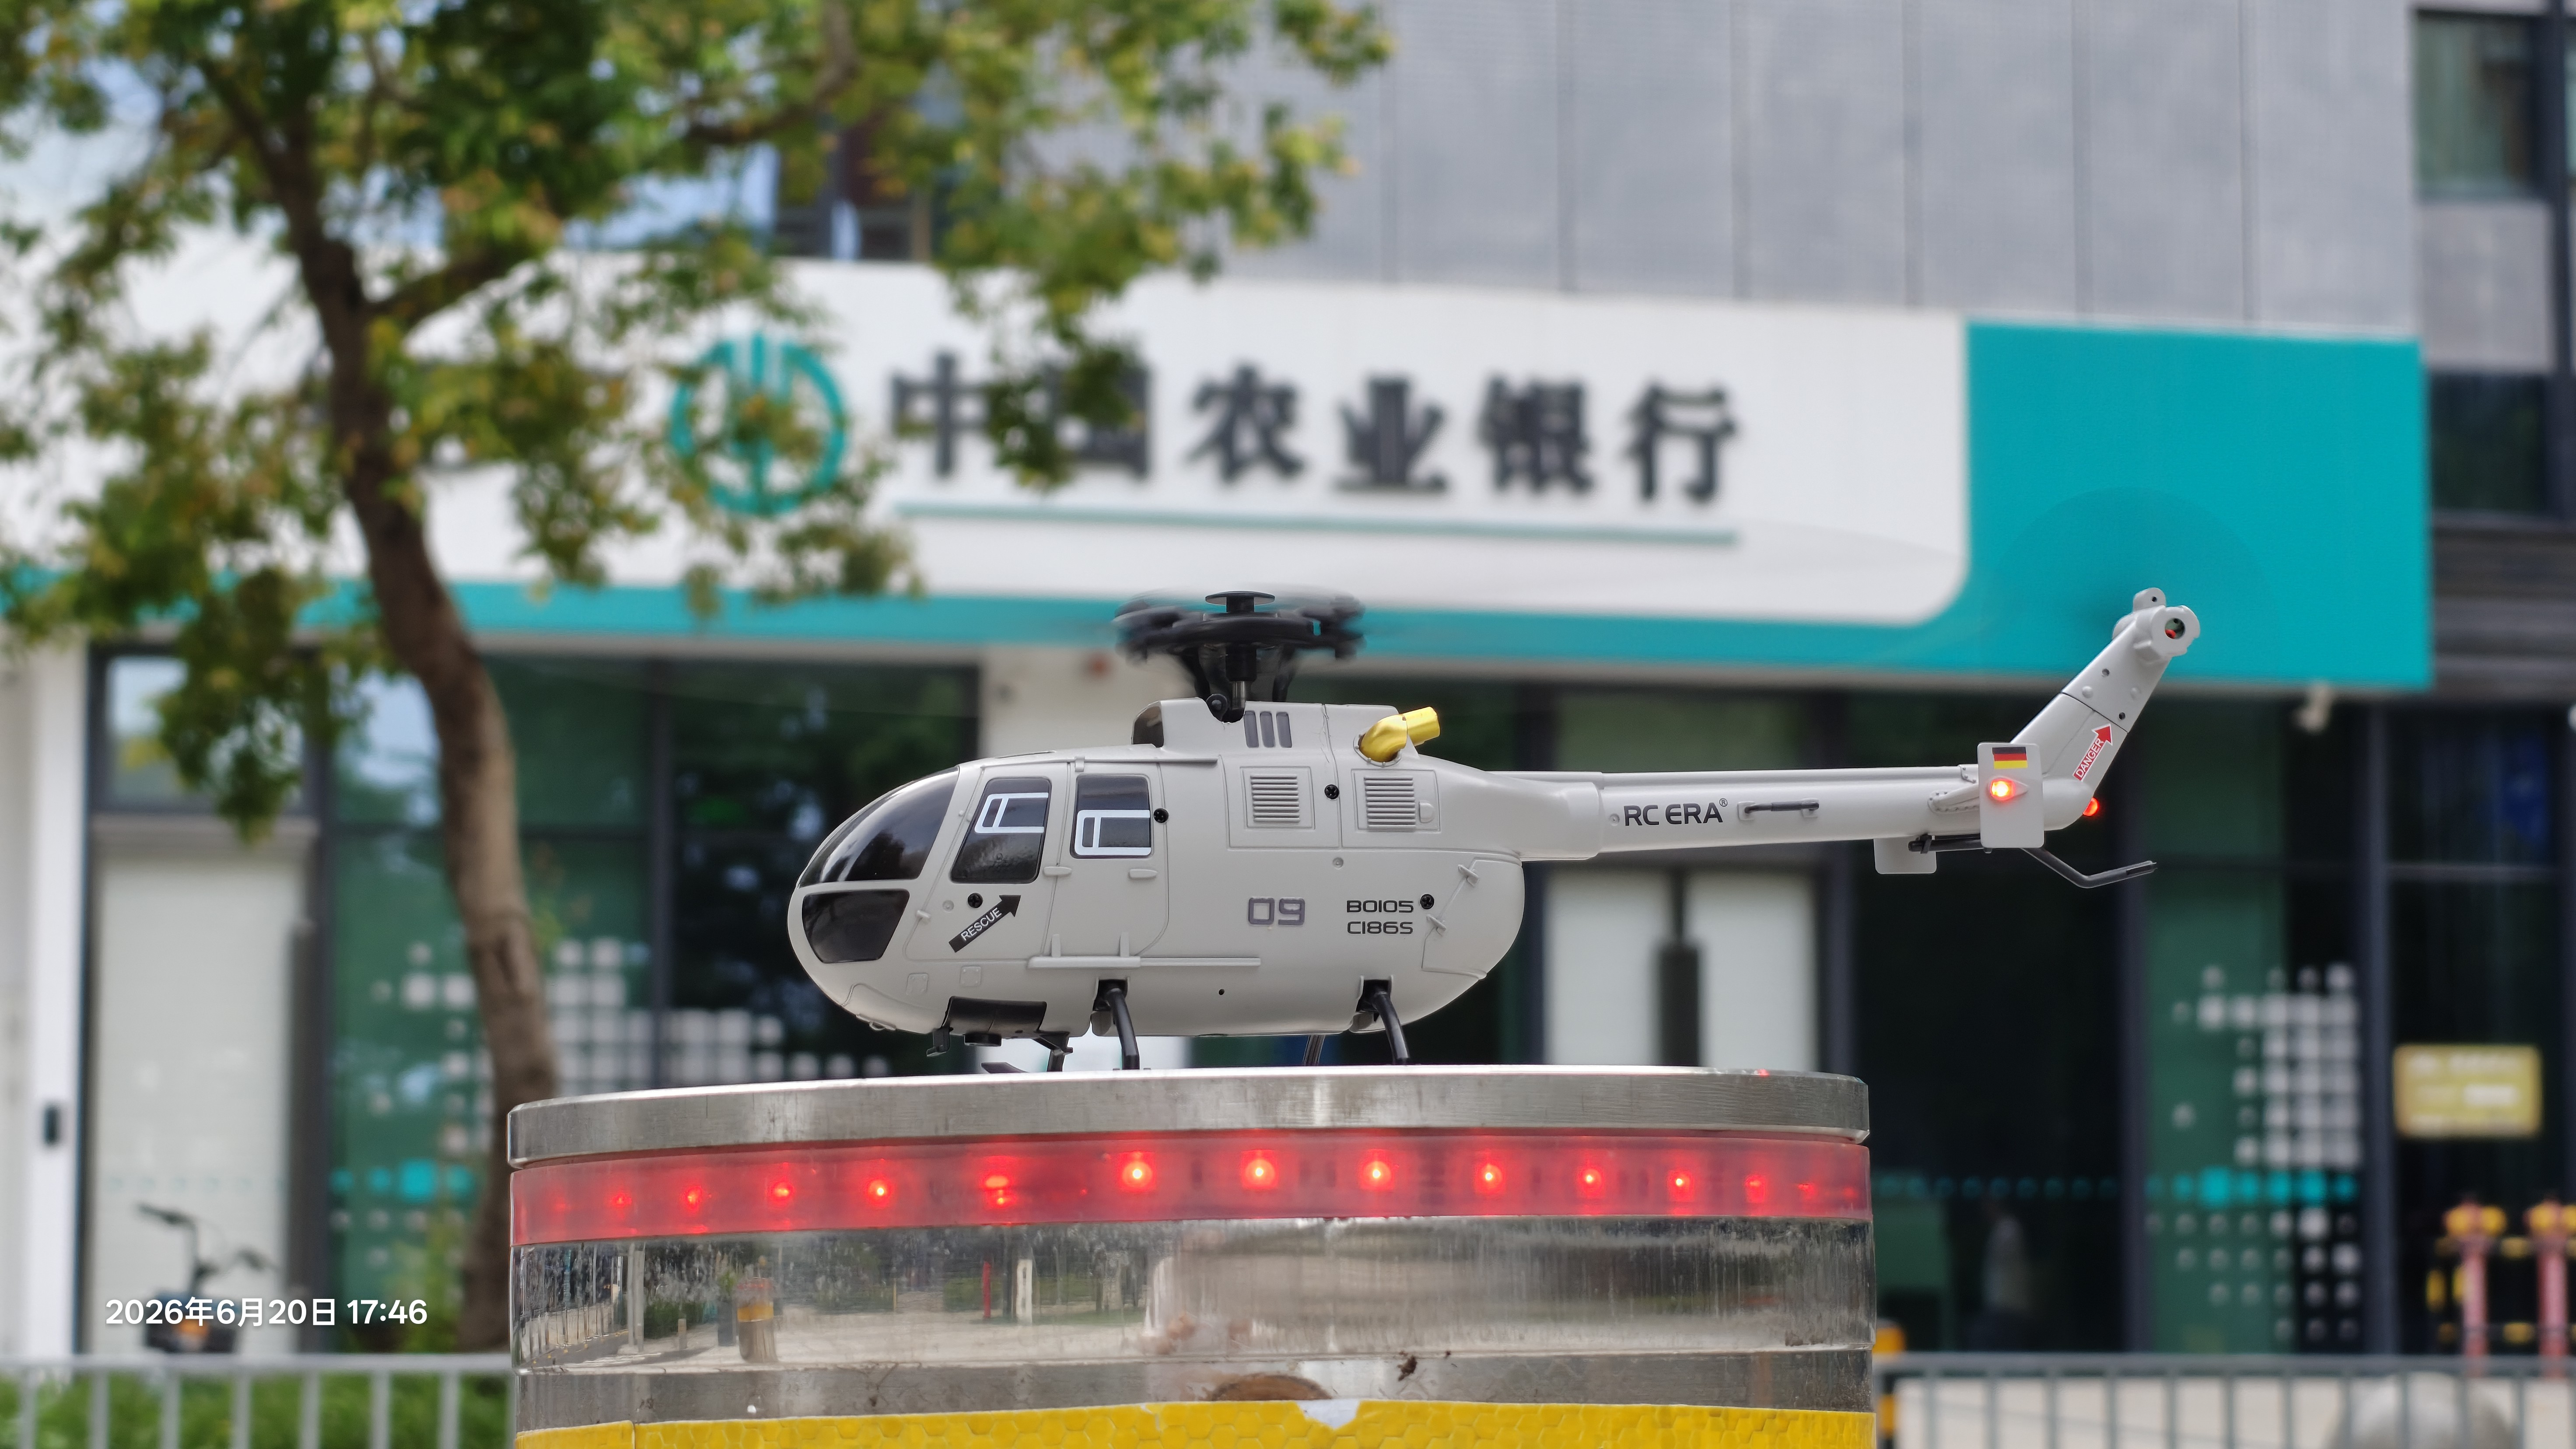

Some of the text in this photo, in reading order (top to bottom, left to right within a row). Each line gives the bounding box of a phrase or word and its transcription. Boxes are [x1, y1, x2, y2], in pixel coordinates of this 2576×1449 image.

[2076, 738, 2104, 778] DANGER
[1624, 805, 1659, 826] RC
[960, 907, 1002, 941] RESCUE
[1248, 898, 1306, 925] 09
[1347, 921, 1414, 934] C186S
